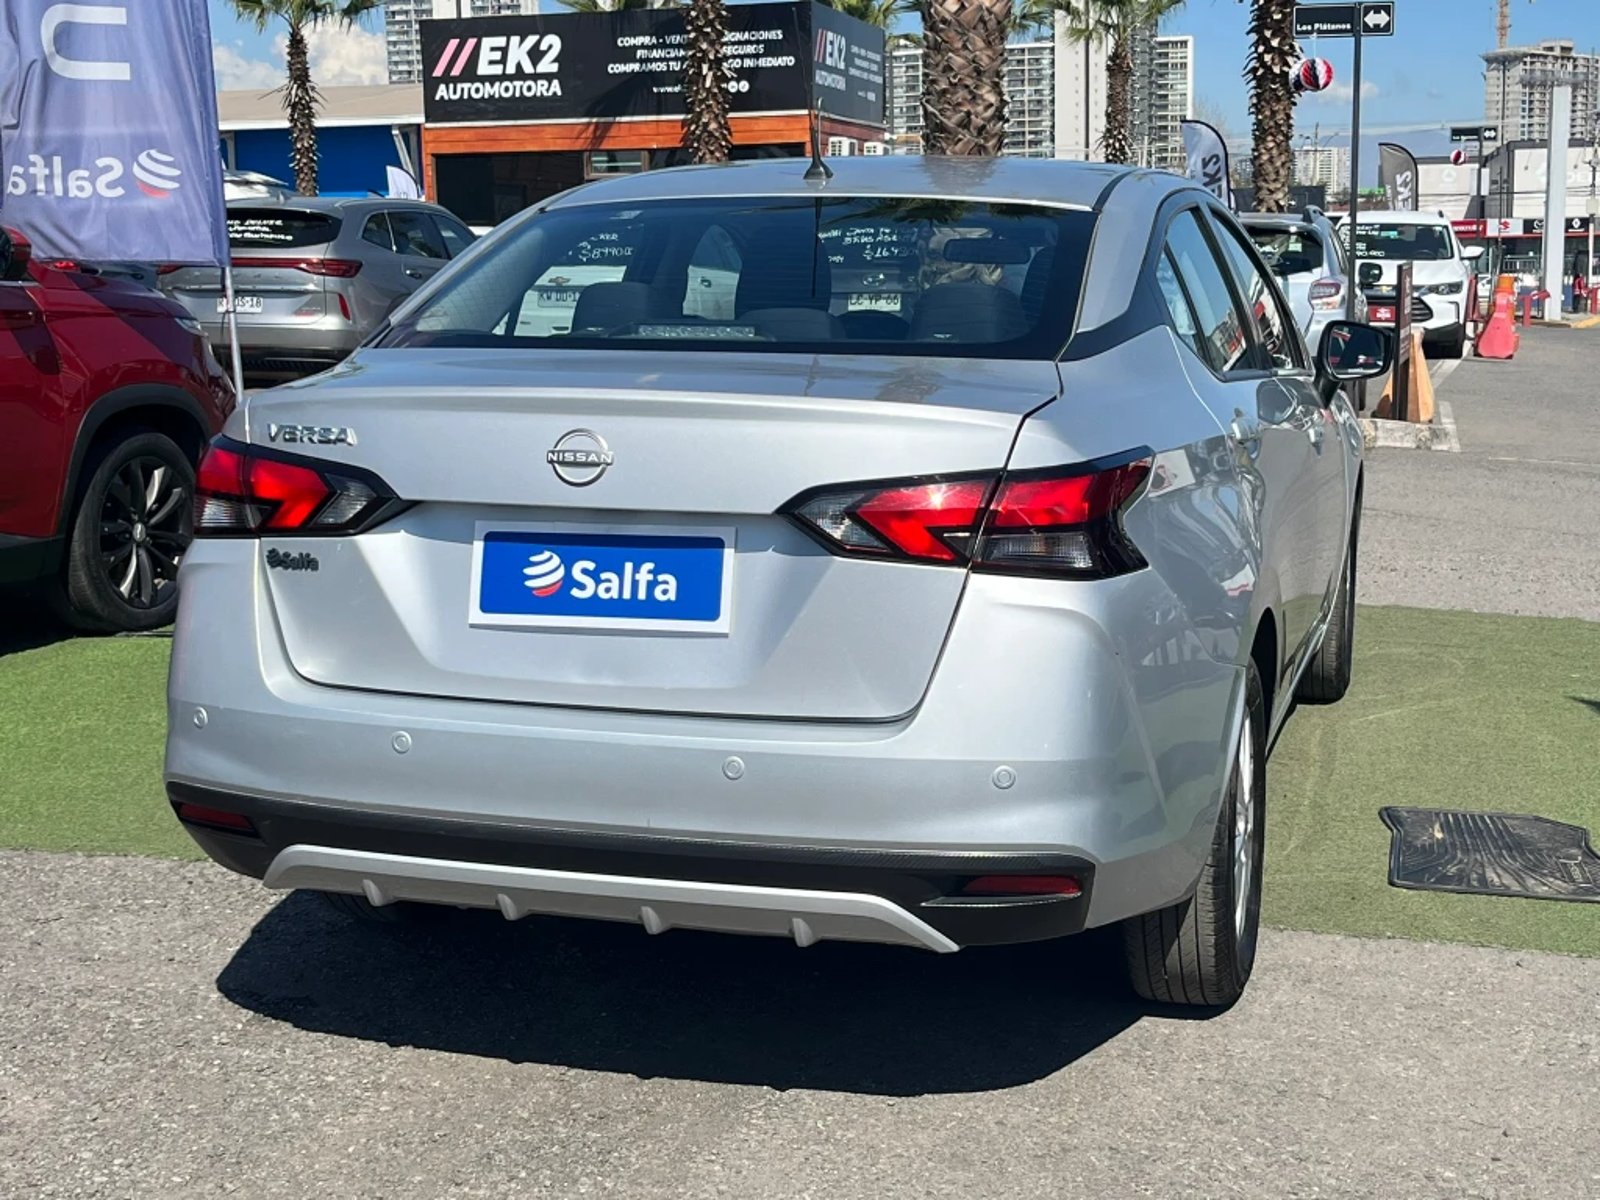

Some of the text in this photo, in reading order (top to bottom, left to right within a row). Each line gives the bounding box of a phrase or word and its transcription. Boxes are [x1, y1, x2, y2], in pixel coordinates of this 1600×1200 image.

[1296, 23, 1312, 31] Los
[617, 35, 657, 47] COMPRA
[607, 61, 668, 74] COMPRAMOS
[669, 60, 681, 71] TU
[743, 55, 795, 68] INMEDIATO
[434, 79, 562, 100] AUTOMOTORA
[266, 423, 358, 446] VERSA
[547, 451, 614, 464] NISSAN
[281, 551, 320, 571] Salfa
[570, 560, 678, 602] Salfa
